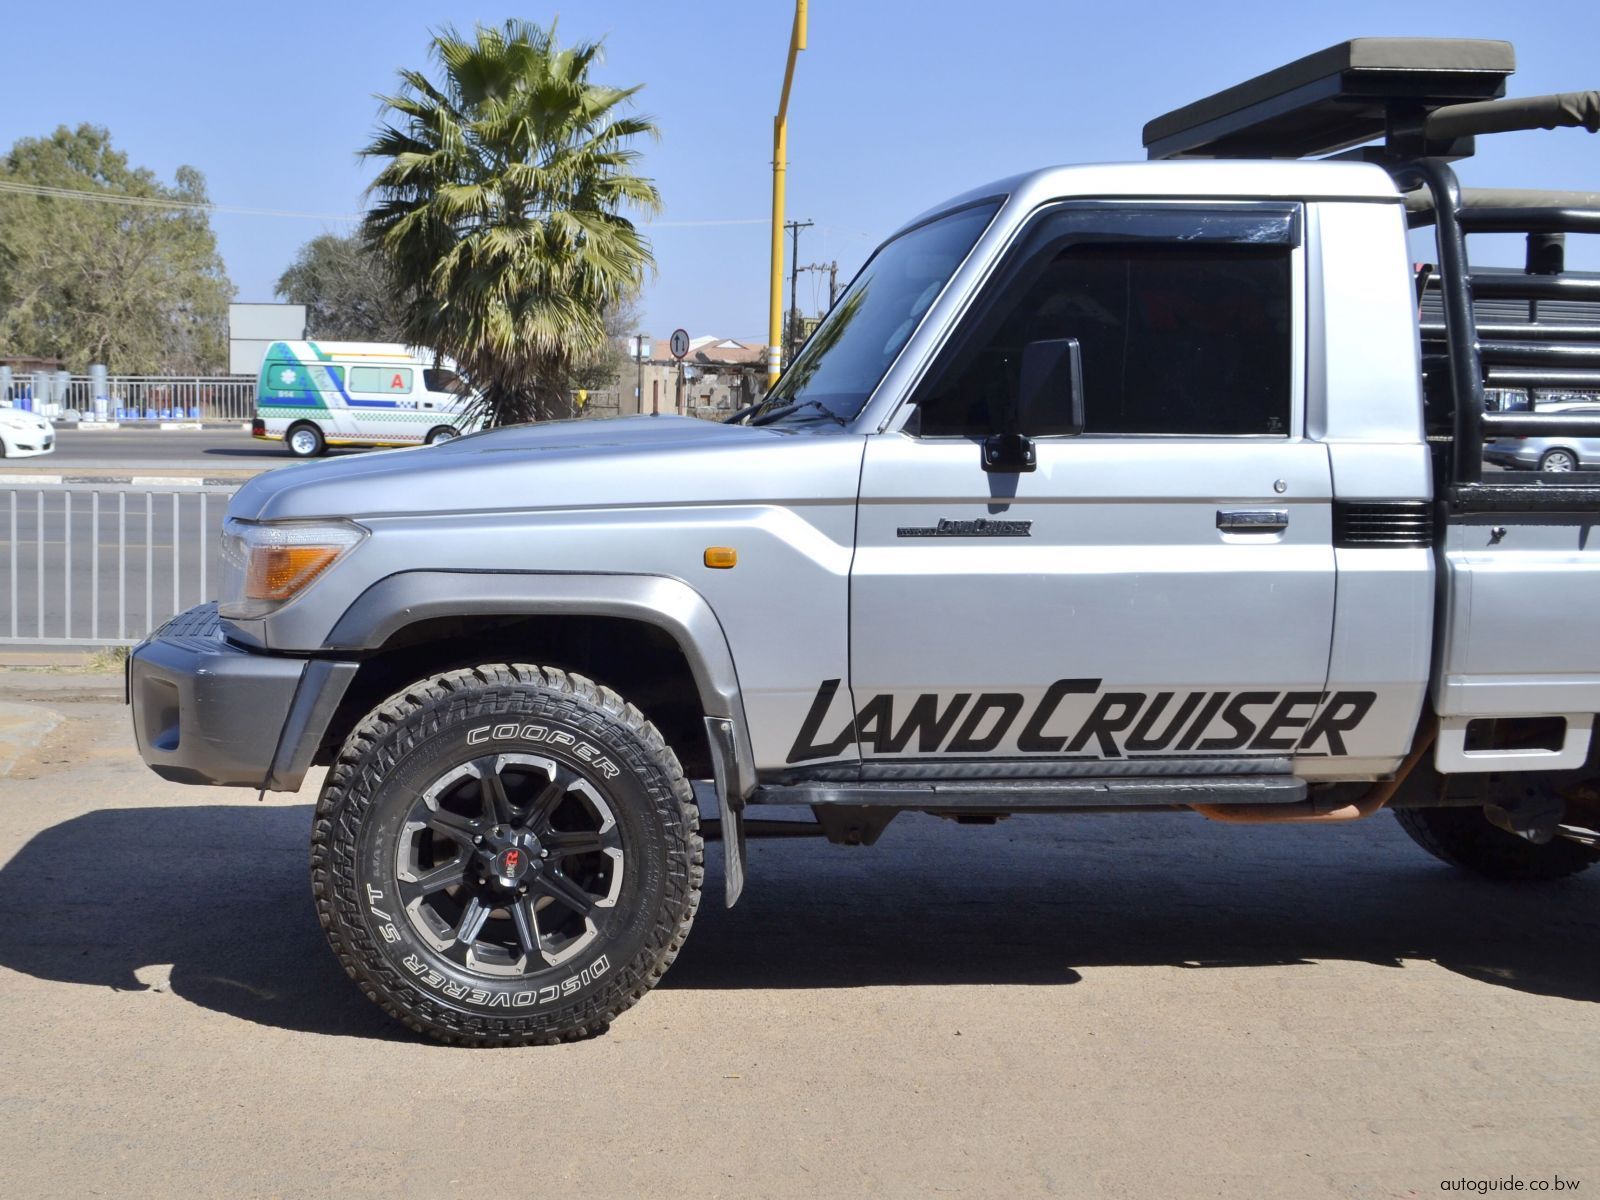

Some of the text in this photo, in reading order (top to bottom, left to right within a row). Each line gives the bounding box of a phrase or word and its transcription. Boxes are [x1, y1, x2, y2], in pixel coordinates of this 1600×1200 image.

[391, 374, 404, 388] A
[466, 724, 620, 780] COOPER
[786, 678, 1377, 763] LAND CRUISER
[366, 883, 611, 1007] DISCOVERER S/T
